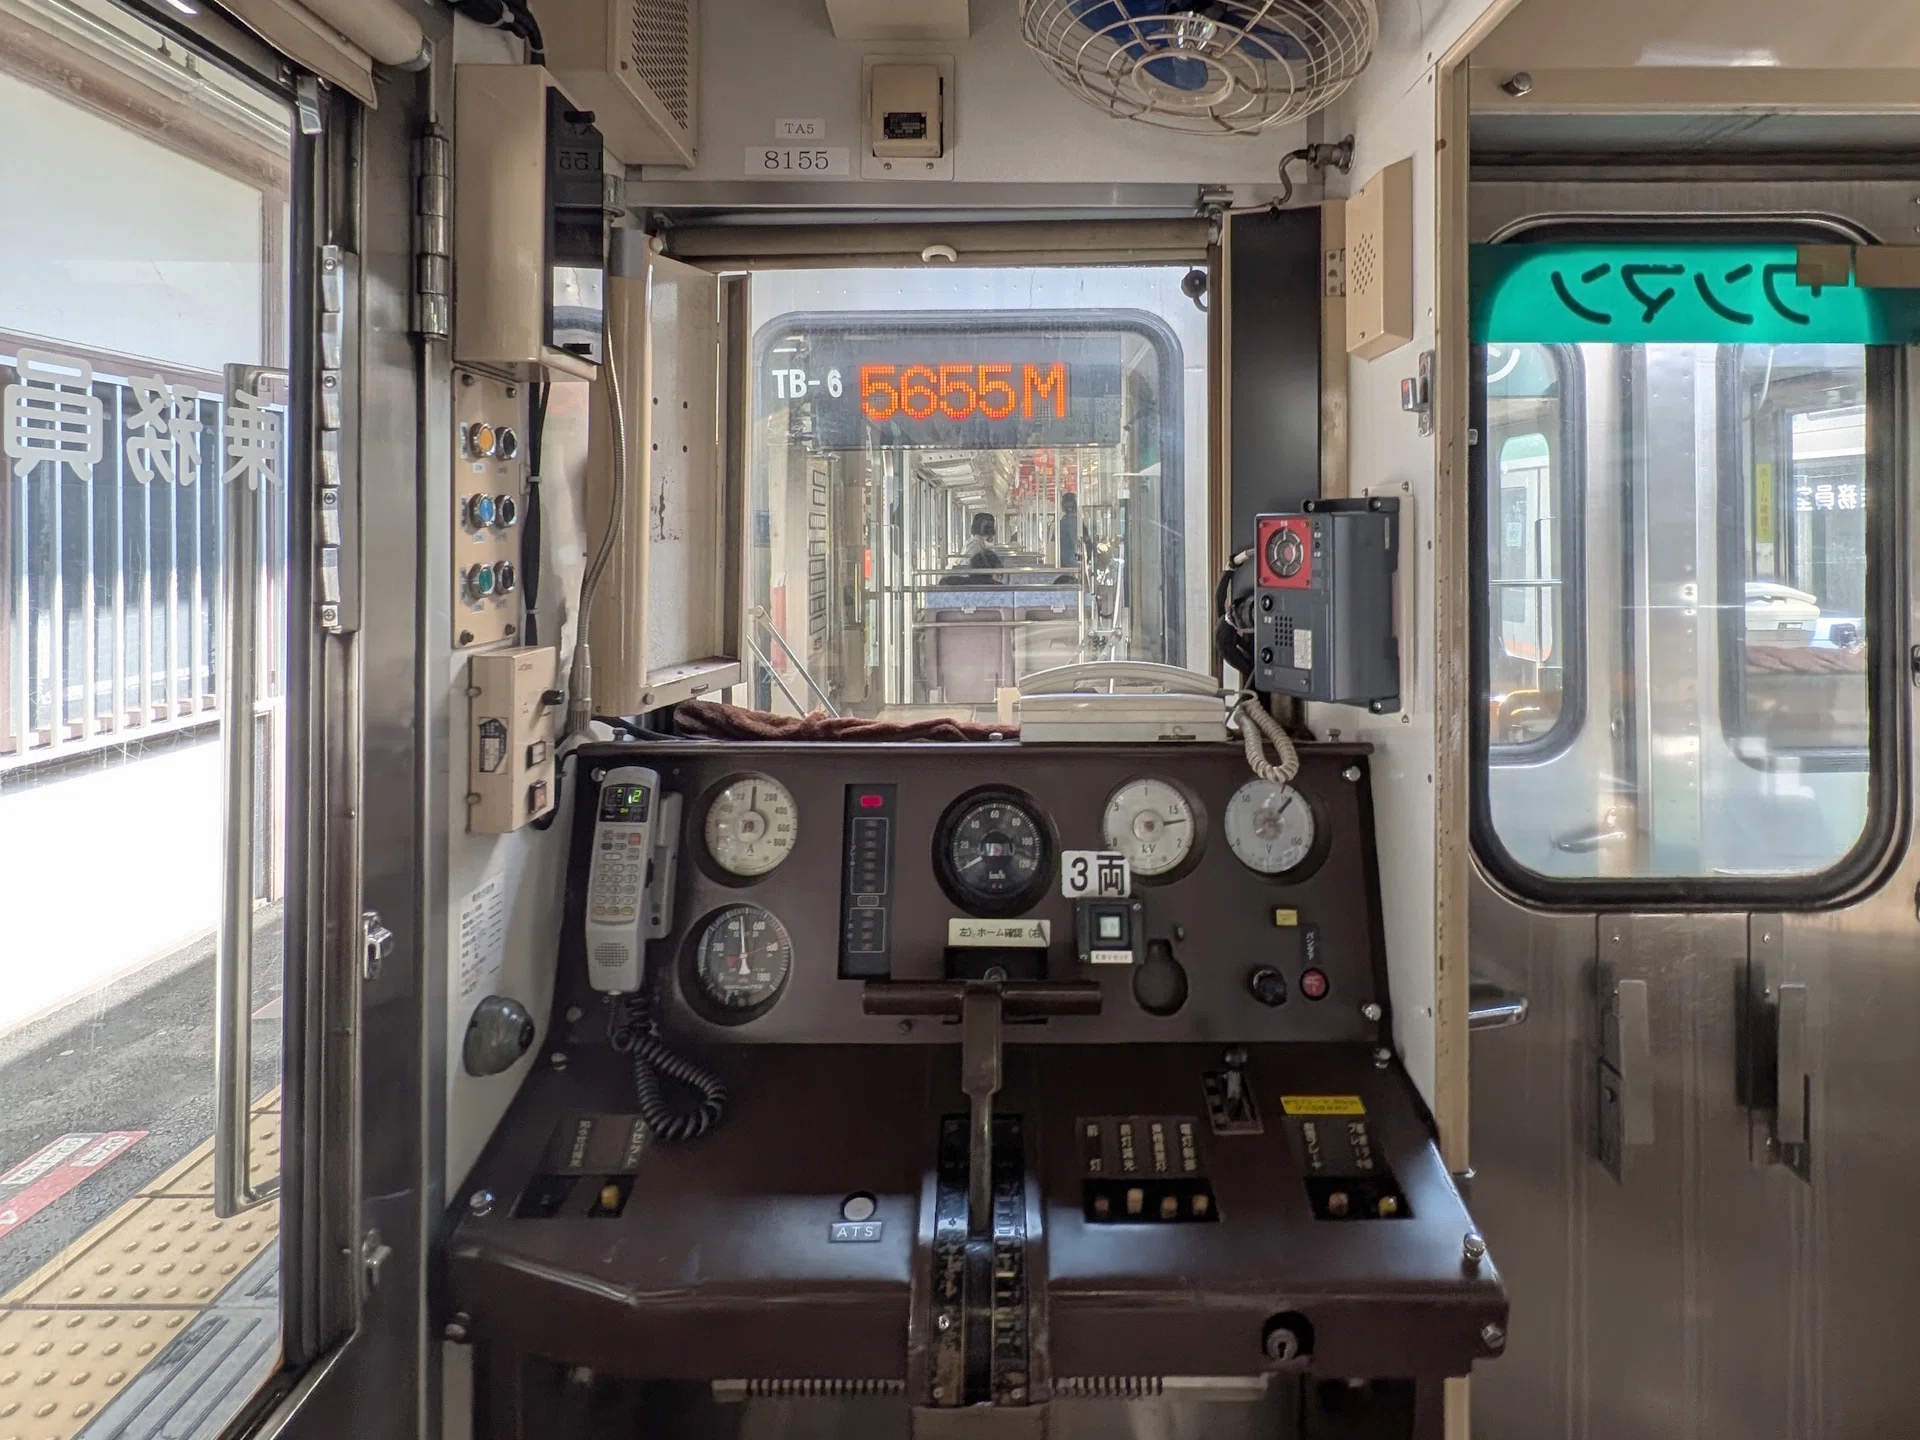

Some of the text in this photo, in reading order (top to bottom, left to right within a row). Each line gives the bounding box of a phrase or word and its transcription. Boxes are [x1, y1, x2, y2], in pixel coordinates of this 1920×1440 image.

[784, 122, 815, 135] TA5
[763, 150, 829, 170] 8155
[860, 361, 1067, 421] 5655M
[990, 809, 1000, 819] 60
[970, 820, 980, 829] 40
[1011, 817, 1021, 827] 80
[959, 840, 970, 849] 20
[1021, 836, 1033, 846] 100
[1141, 843, 1157, 854] kV
[1019, 859, 1031, 869] 120
[1070, 854, 1127, 896] 3両
[836, 1226, 874, 1238] ATS
